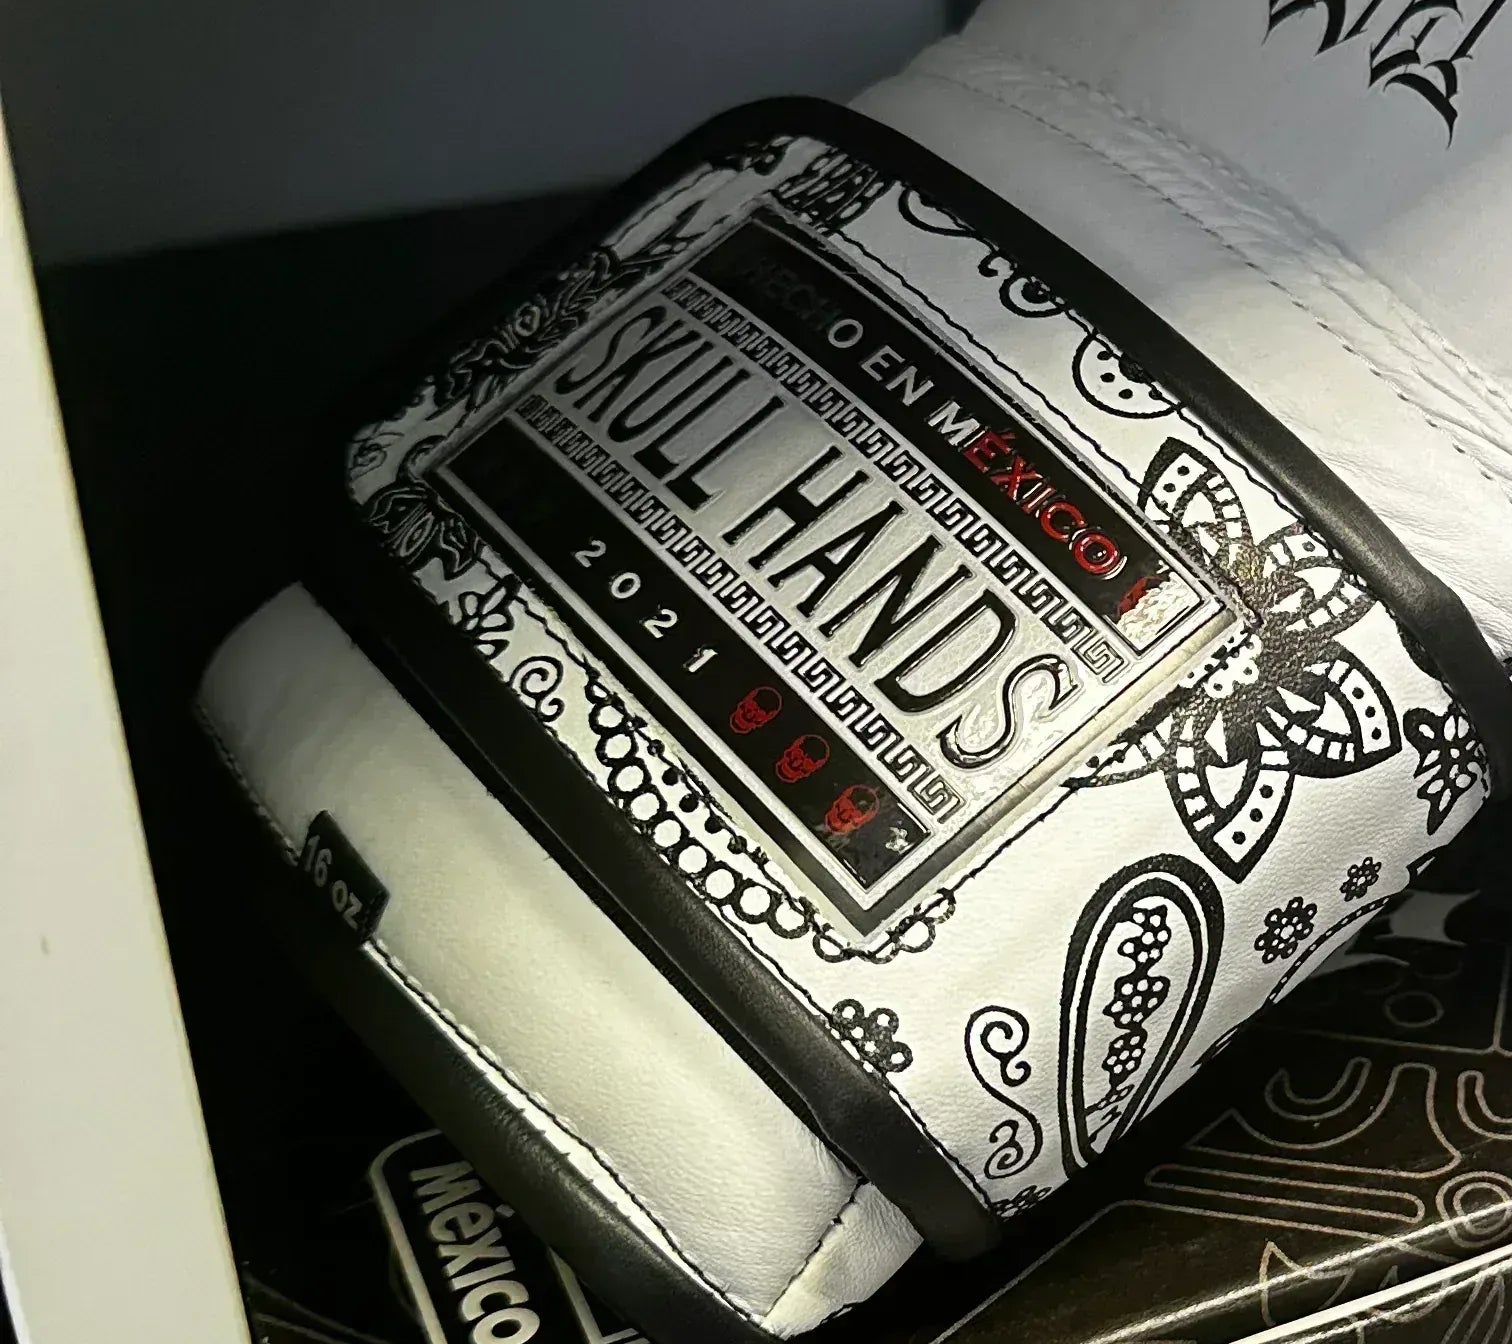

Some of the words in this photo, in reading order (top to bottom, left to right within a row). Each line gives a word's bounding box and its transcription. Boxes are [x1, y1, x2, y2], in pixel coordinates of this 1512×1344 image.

[554, 302, 789, 509] SKULL
[720, 446, 1080, 771] HANDS
[860, 345, 934, 408] EN
[928, 407, 1126, 580] MÉXICO
[575, 539, 714, 675] 2021
[304, 836, 331, 886] 16
